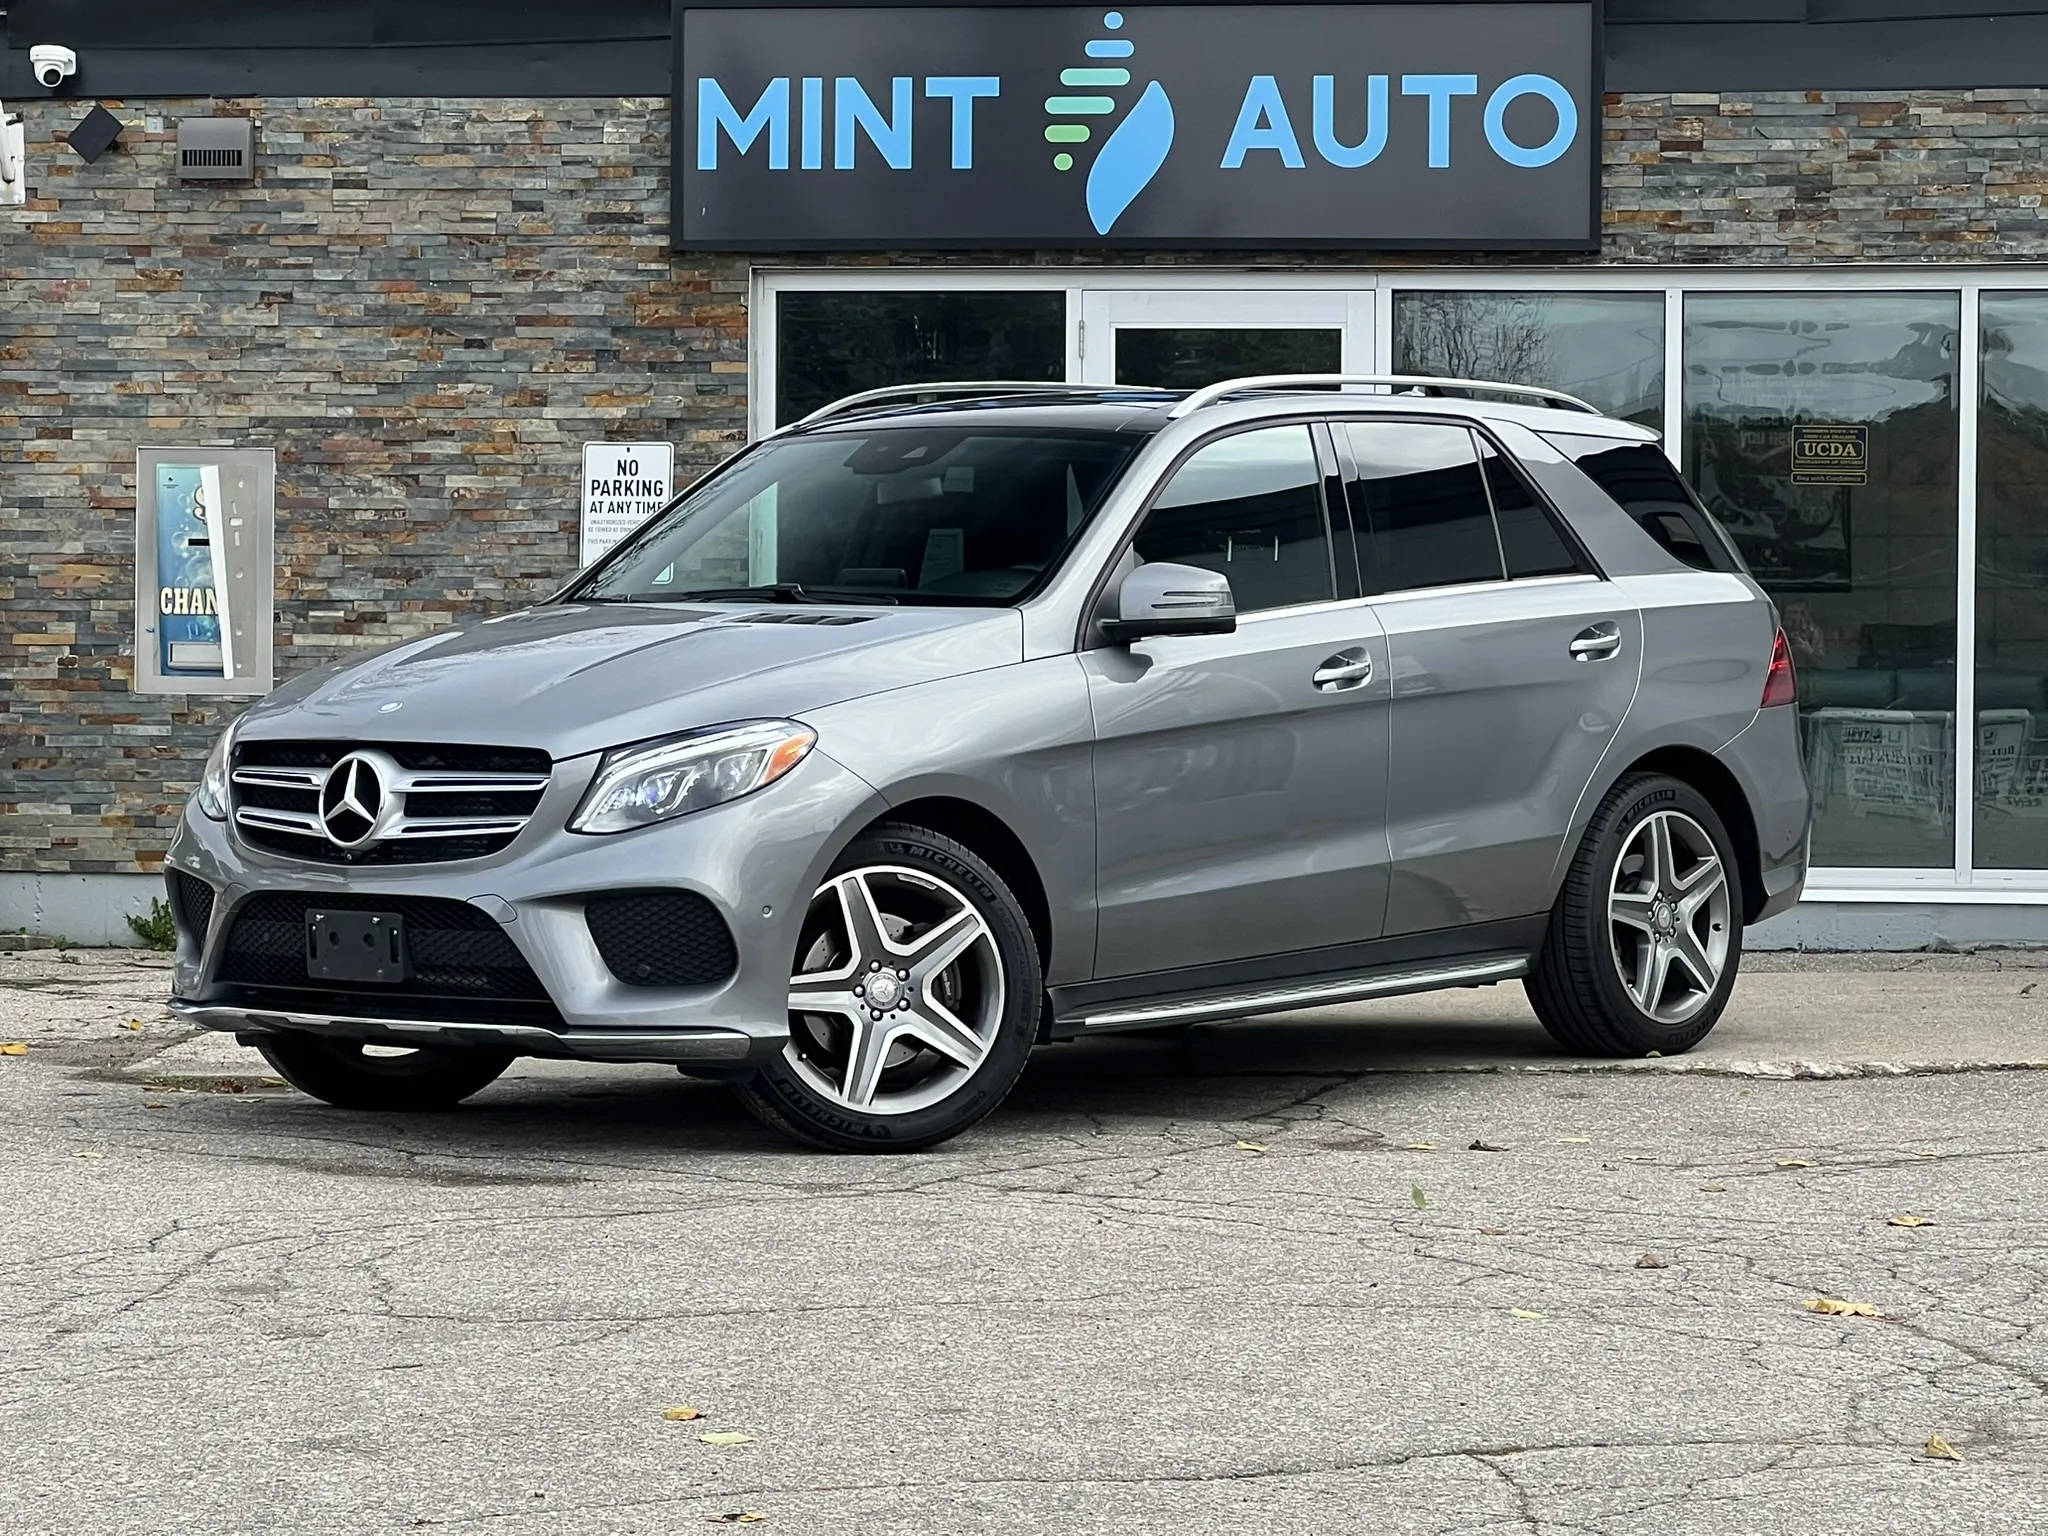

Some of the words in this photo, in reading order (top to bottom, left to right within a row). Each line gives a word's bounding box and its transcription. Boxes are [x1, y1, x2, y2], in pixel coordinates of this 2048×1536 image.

[696, 76, 1001, 171] MINT
[1219, 73, 1579, 169] AUTO
[1803, 442, 1857, 457] UCDA
[616, 459, 639, 477] NO
[590, 479, 664, 497] PARKING
[589, 500, 604, 514] AT
[607, 501, 632, 514] ANY
[160, 585, 219, 616] CHAN
[1626, 790, 1673, 821] MICHELIN
[908, 845, 995, 901] MICHELIN
